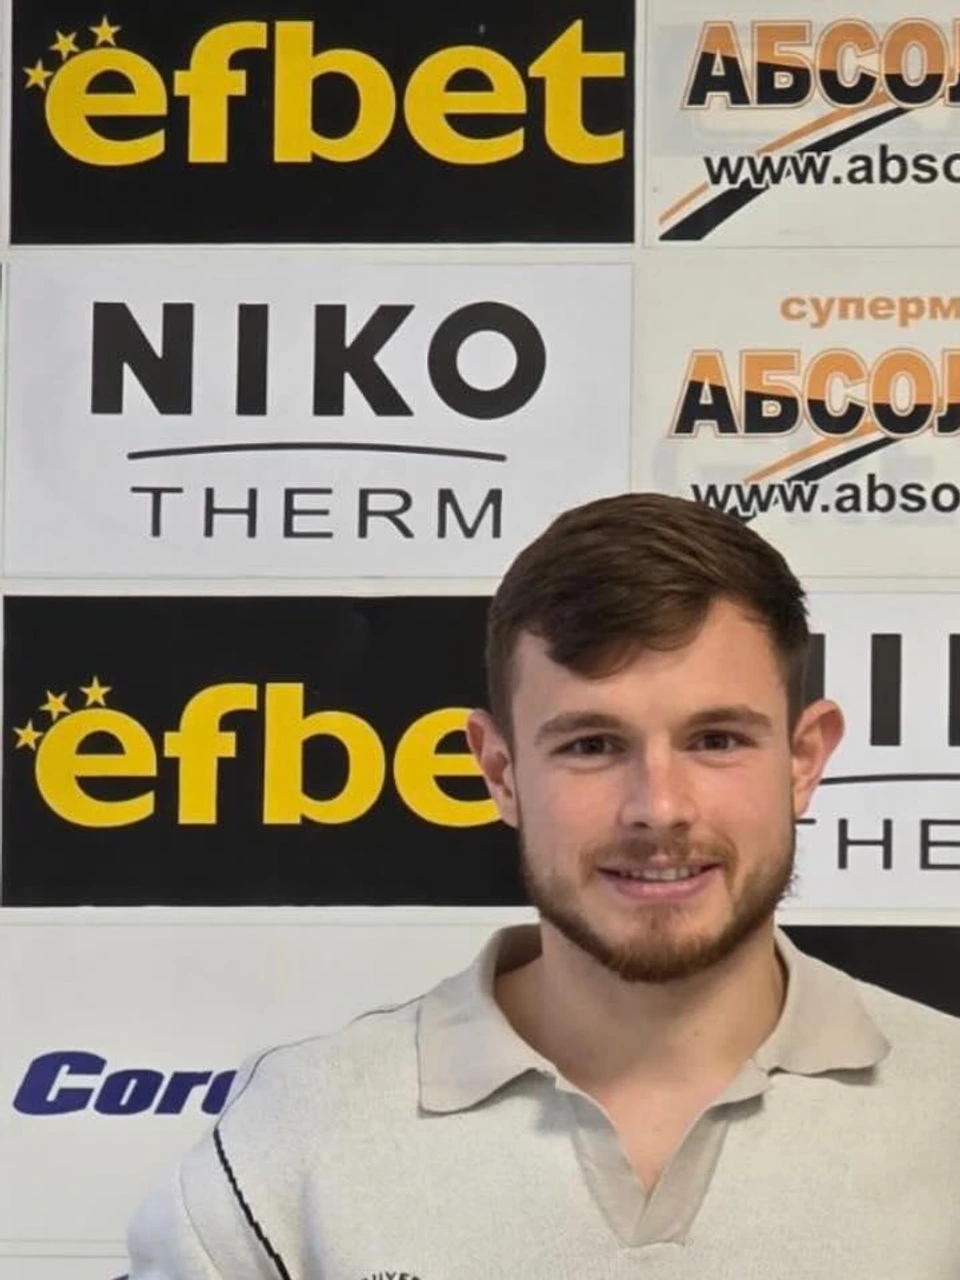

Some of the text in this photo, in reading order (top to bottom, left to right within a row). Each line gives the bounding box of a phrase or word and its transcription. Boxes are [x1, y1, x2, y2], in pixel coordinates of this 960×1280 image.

[44, 20, 626, 167] efbet
[91, 301, 547, 420] NIKO
[130, 486, 502, 539] THERM
[35, 682, 500, 828] efbe
